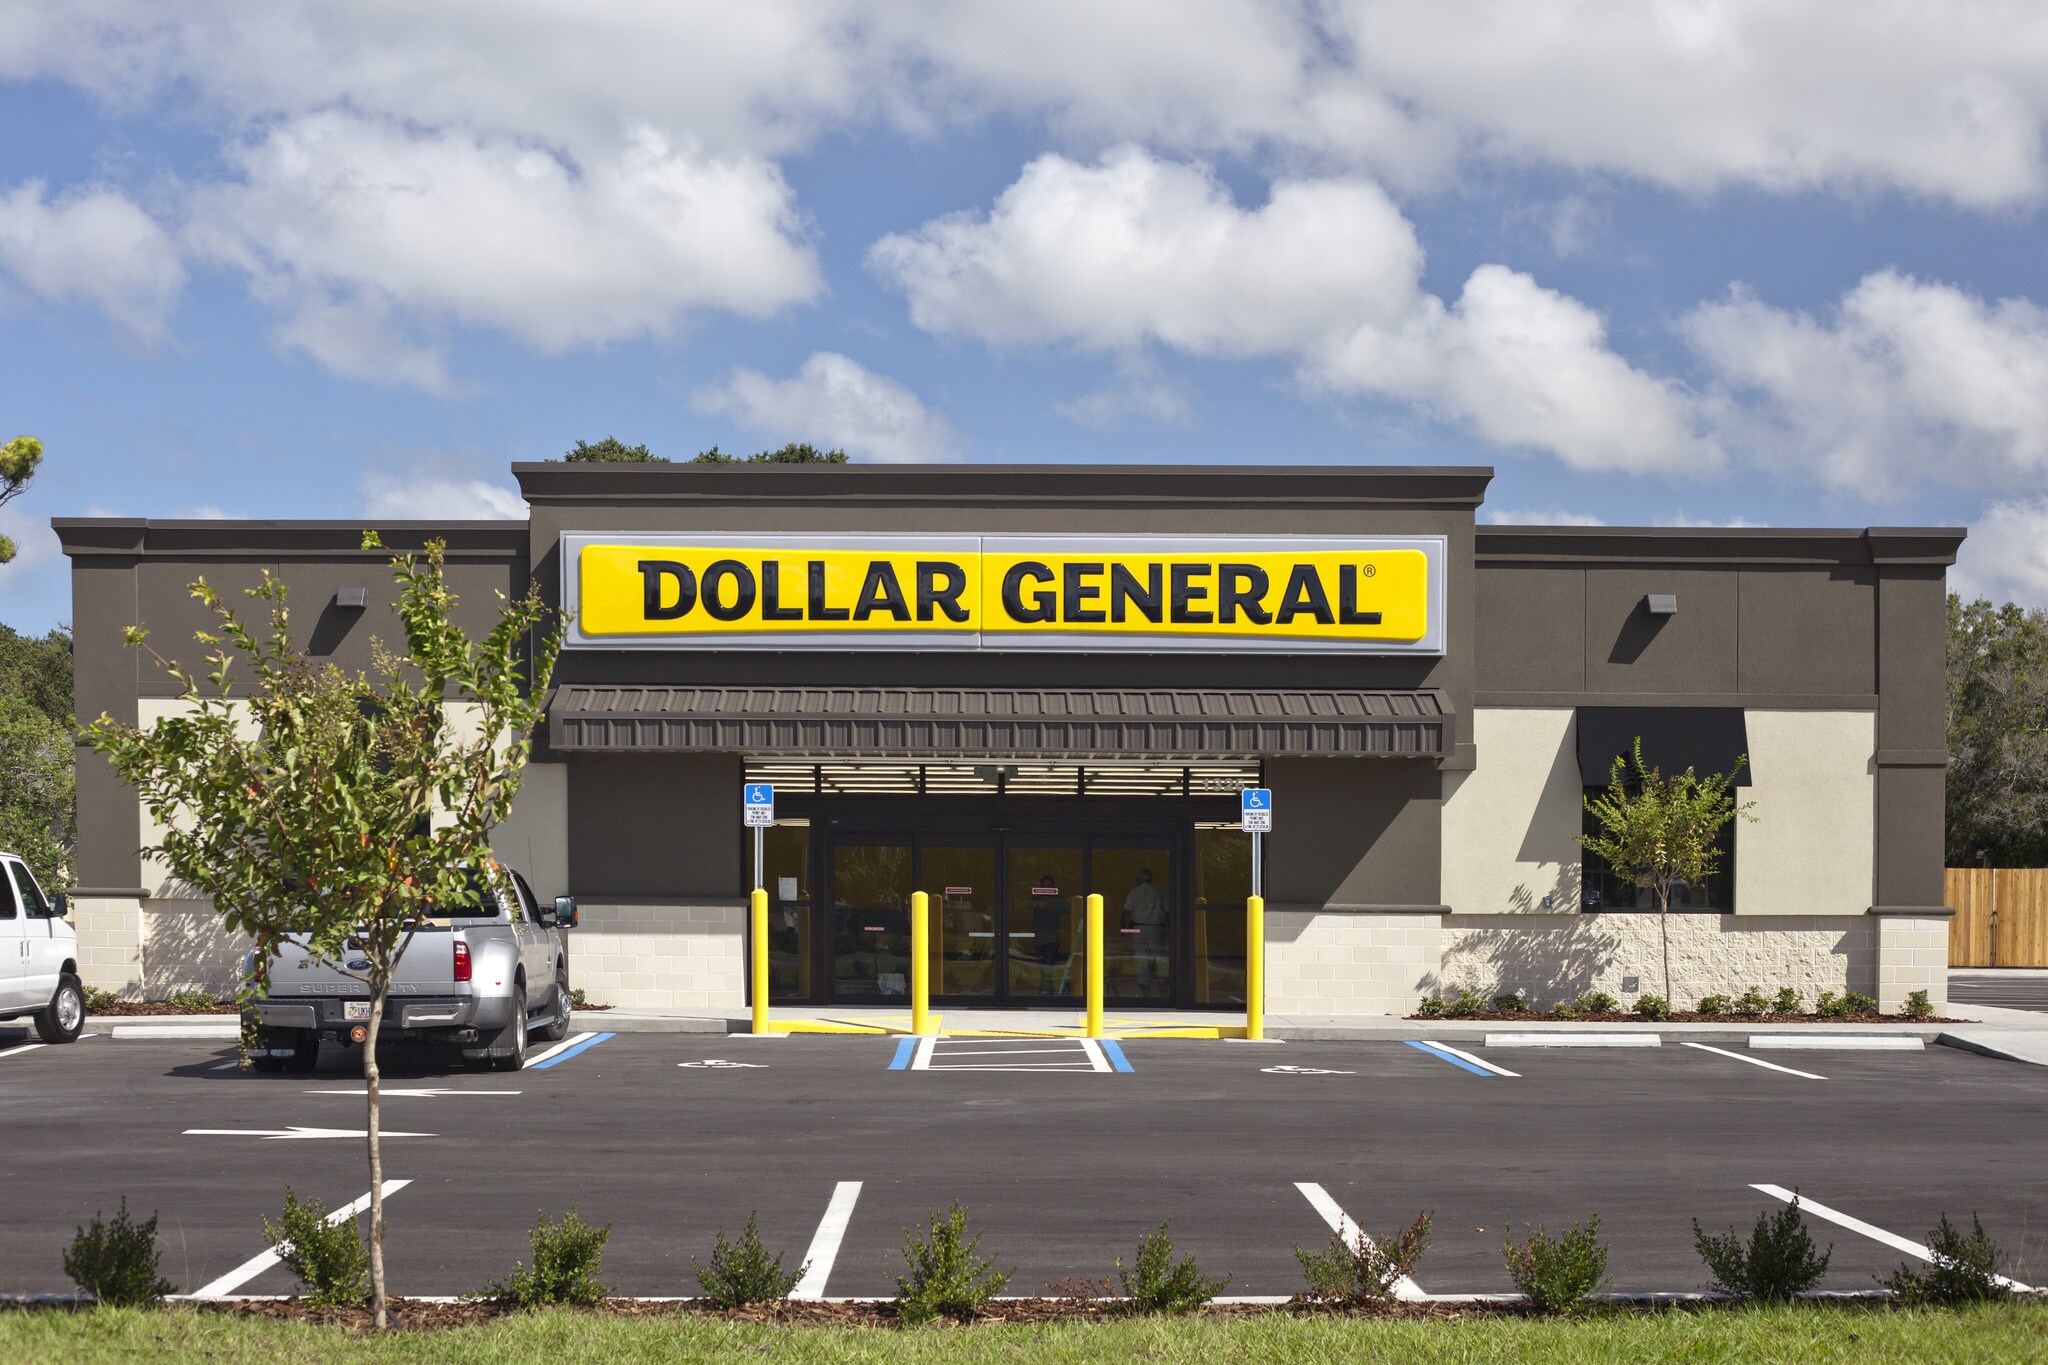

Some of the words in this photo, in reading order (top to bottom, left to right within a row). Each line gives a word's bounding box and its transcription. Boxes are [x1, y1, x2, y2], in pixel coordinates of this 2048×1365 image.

[638, 559, 970, 622] DOLLAR
[1002, 561, 1382, 625] GENERAL
[1202, 778, 1245, 791] 1326
[300, 984, 360, 993] SUPER
[388, 984, 418, 993] UTY
